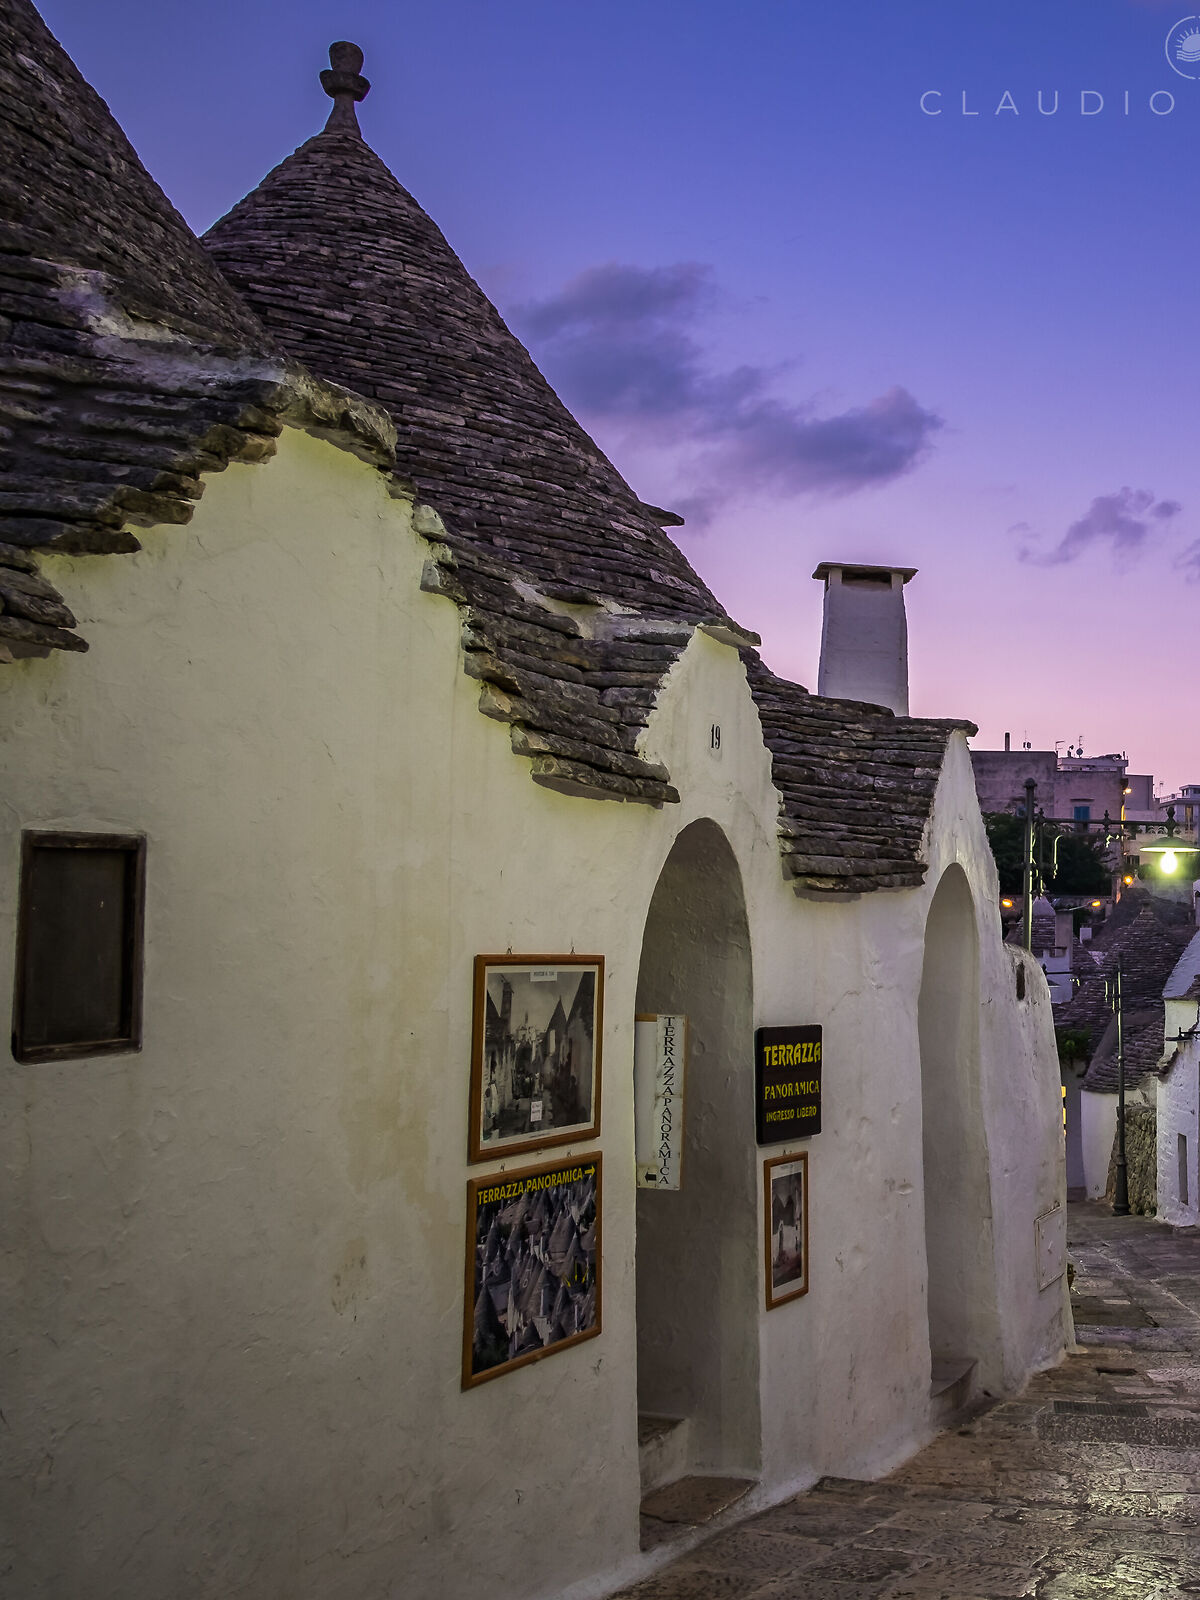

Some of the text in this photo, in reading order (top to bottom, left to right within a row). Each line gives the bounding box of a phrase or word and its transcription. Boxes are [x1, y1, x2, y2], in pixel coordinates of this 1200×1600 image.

[710, 724, 721, 750] 19
[763, 1041, 821, 1067] TERRAZZA
[658, 1016, 676, 1185] TERRAZZA PANORAMICA
[764, 1080, 820, 1101] PANORAMICA
[766, 1105, 817, 1122] INGRESSO LIBERO
[477, 1167, 584, 1206] TERRAZZA PANORAMICA
